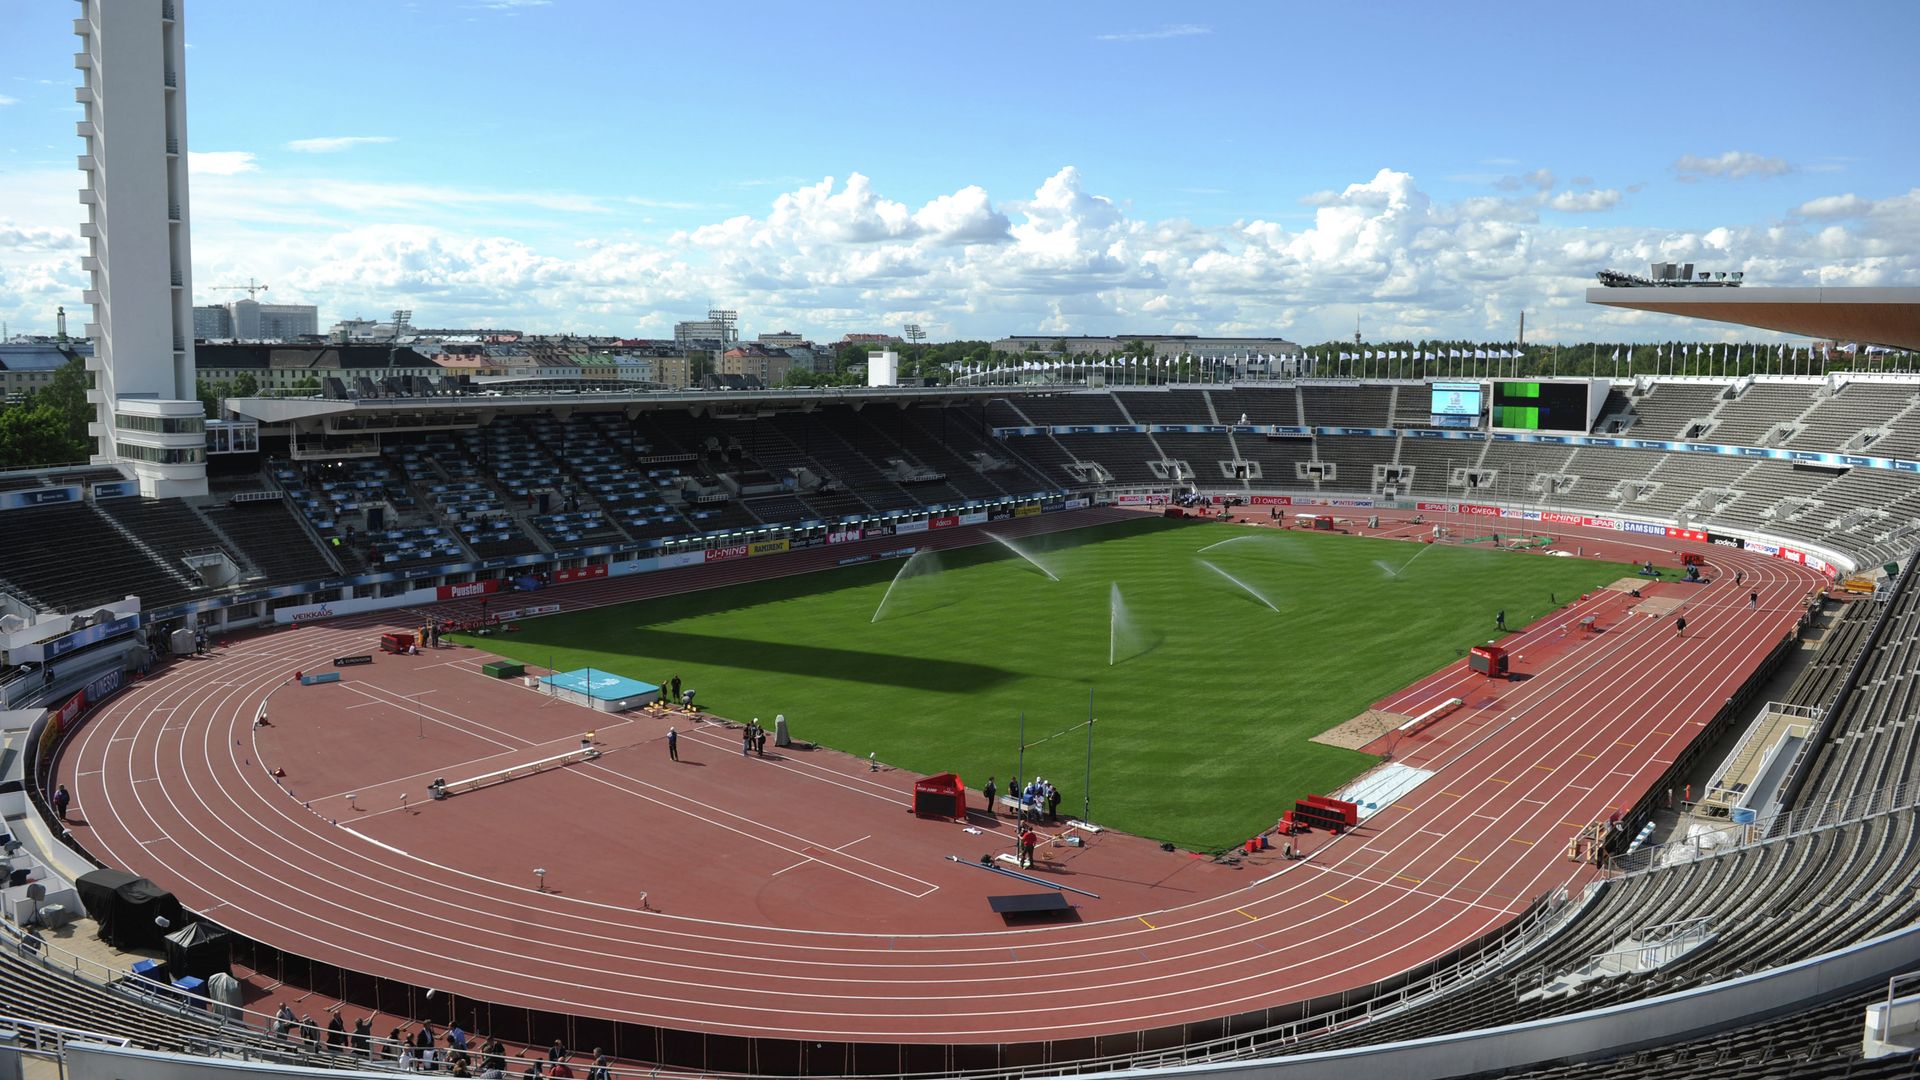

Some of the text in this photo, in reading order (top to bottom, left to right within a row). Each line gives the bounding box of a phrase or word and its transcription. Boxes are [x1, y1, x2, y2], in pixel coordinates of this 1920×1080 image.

[1424, 503, 1448, 511] SPAR
[1471, 506, 1498, 516] OMEGA
[1543, 512, 1580, 523] LI-NING
[936, 519, 952, 527] Adecco
[1591, 519, 1614, 527] SPAR
[1624, 523, 1665, 535] SAMSUNG
[1714, 539, 1738, 548] sodexo
[707, 546, 746, 559] LI-NING
[452, 582, 484, 597] Puustelli
[292, 610, 333, 620] VEIKKAUS
[95, 671, 119, 697] UNESCO
